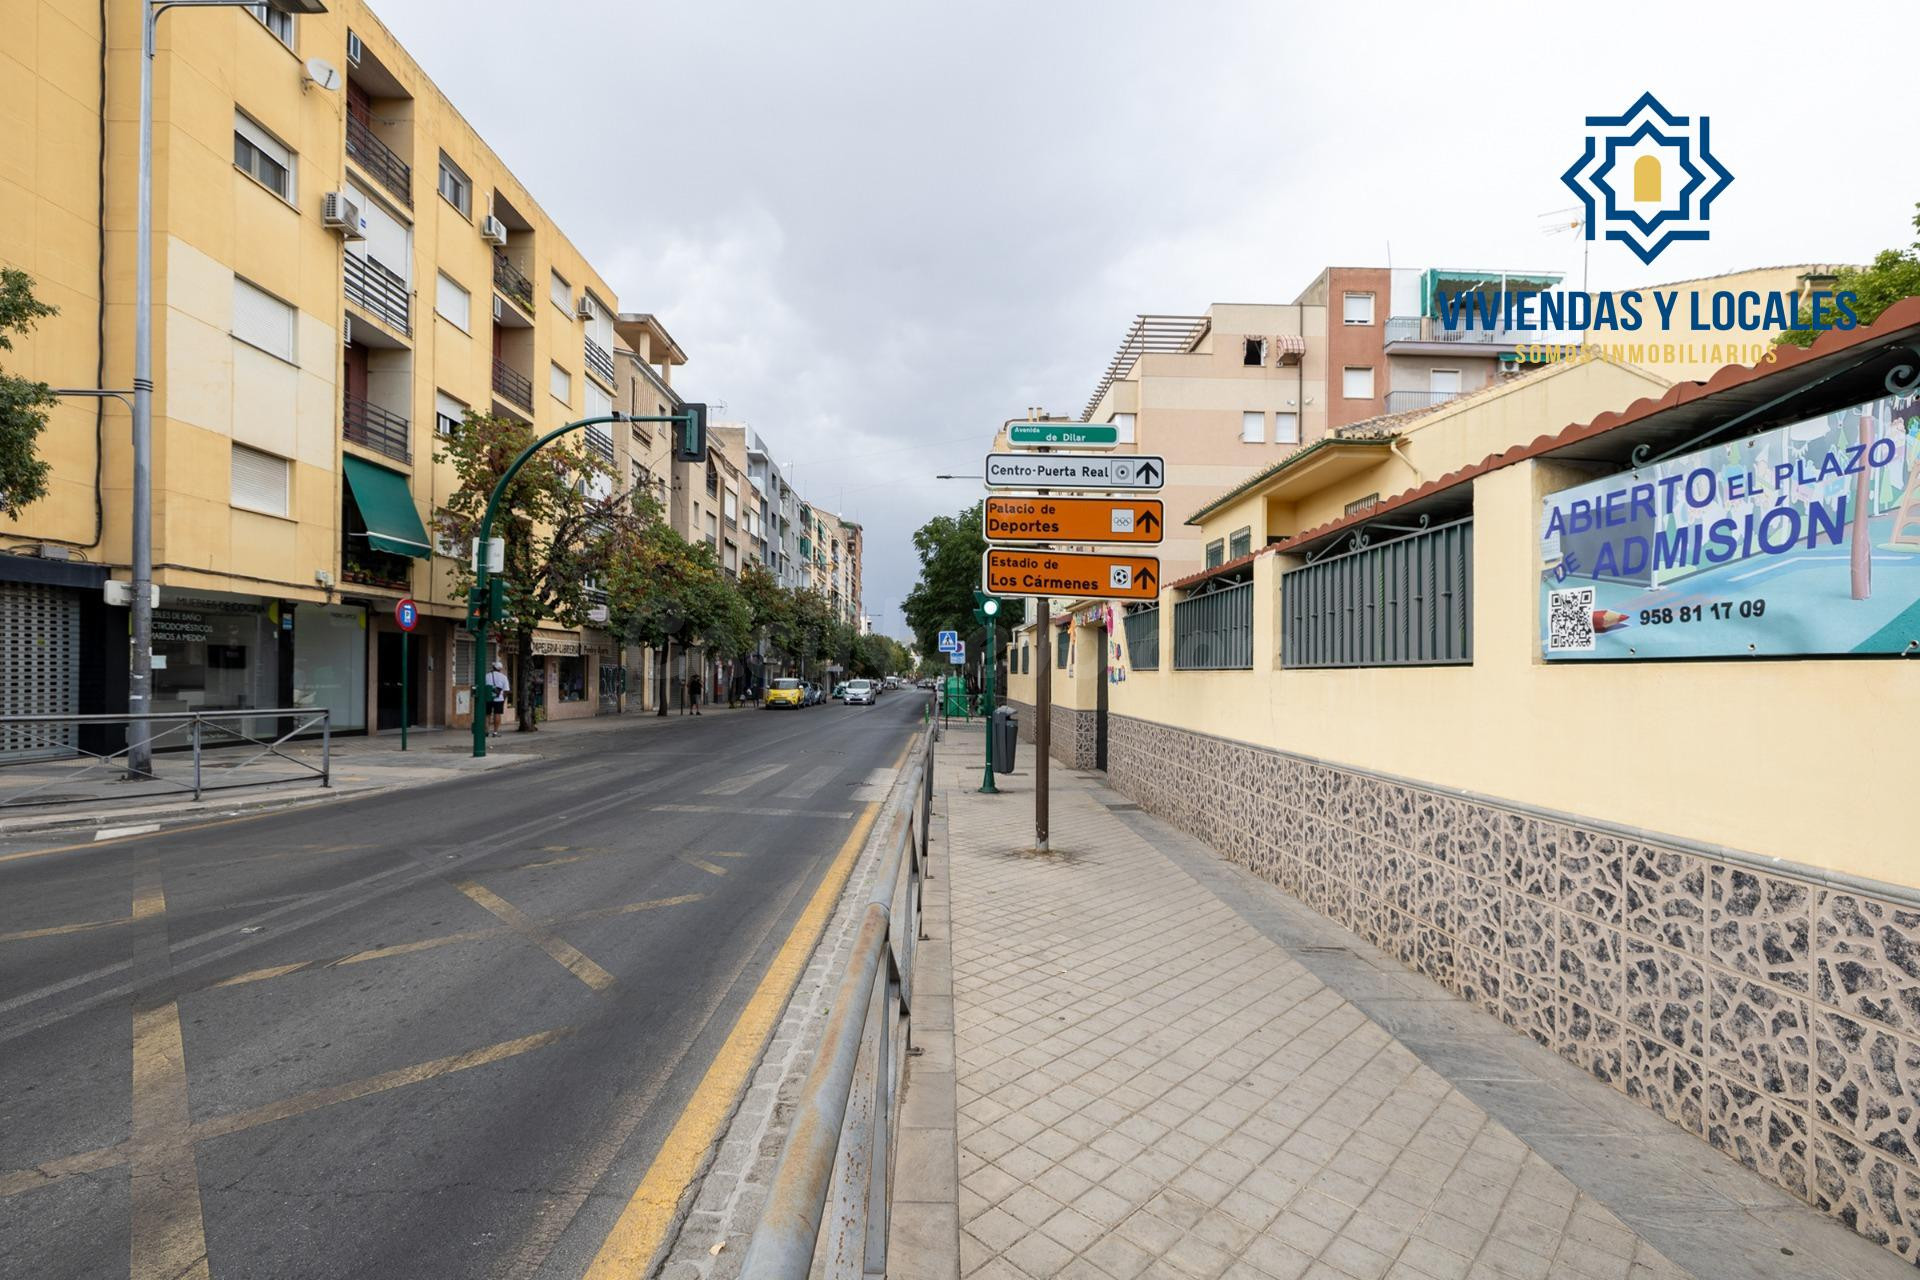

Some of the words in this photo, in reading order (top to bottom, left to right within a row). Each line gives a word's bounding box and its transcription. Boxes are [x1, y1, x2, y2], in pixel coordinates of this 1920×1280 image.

[1045, 433, 1058, 441] de
[991, 464, 1076, 477] Centro-Puerta
[1082, 466, 1109, 478] Real
[1544, 467, 1717, 539] ABIERTO
[1728, 474, 1764, 500] EL
[1775, 438, 1896, 490] PLAZO
[989, 503, 1037, 514] Palacio
[1041, 504, 1056, 514] de
[989, 519, 1060, 534] Deportes
[1553, 551, 1581, 584] DE
[1592, 495, 1848, 580] ADMISIÓN
[991, 557, 1038, 569] Estadio
[1044, 558, 1059, 569] de
[991, 573, 1017, 586] Los
[1023, 574, 1099, 590] Cármenes
[1640, 608, 1673, 625] 958
[1680, 604, 1702, 622] 81
[1710, 602, 1733, 620] 17
[1740, 599, 1766, 618] 09
